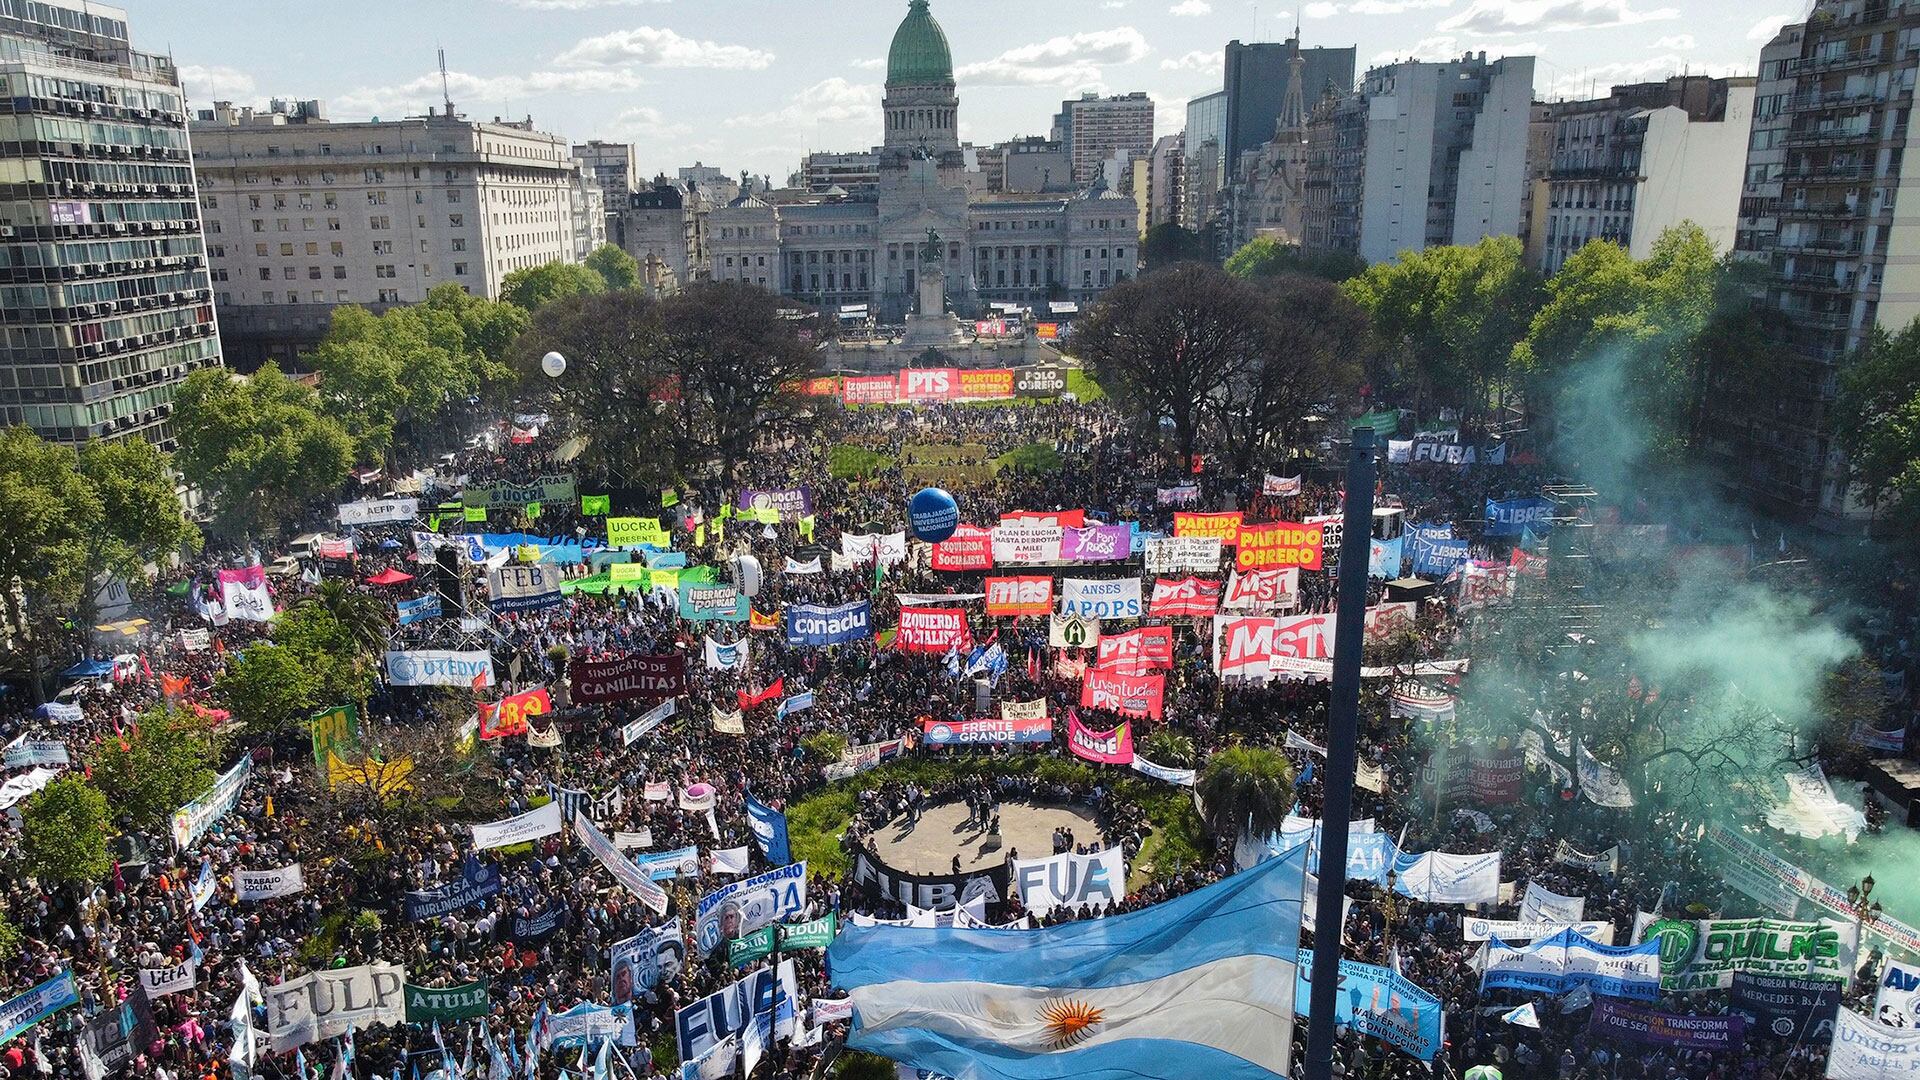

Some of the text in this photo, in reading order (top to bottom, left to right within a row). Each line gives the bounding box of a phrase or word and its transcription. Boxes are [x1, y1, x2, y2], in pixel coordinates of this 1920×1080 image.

[908, 372, 949, 393] PTS
[961, 374, 1011, 383] PARTIDO
[1025, 371, 1056, 380] POLO
[846, 381, 892, 391] IZQUIERDA
[962, 384, 1010, 394] OBRERO
[1018, 380, 1064, 391] OBRERO
[846, 390, 892, 401] SOCIALISTA
[1415, 443, 1476, 464] FUBA
[503, 487, 546, 501] UOCRA
[772, 490, 803, 502] UOCRA
[367, 505, 395, 515] AEFIP
[913, 507, 955, 518] TRABAJADORES
[1499, 507, 1556, 525] LIBRES
[612, 521, 656, 532] UOCRA
[1177, 516, 1240, 529] PARTIDO
[615, 535, 657, 544] PRESENTE
[1021, 536, 1060, 544] DERROTAR
[1241, 530, 1320, 548] PARTIDO
[939, 541, 983, 553] IZQUIERDA
[938, 554, 986, 566] SOCIALISTA
[1239, 548, 1314, 566] OBRERO
[500, 568, 543, 587] FEB
[688, 586, 737, 602] LIBERACIÓN
[1081, 584, 1121, 594] ANSES
[694, 598, 736, 613] POPULAR
[1064, 598, 1139, 617] APOPS
[795, 610, 866, 634] conadu
[901, 612, 960, 629] IZQUIERDA
[1101, 633, 1142, 658] PTS
[1229, 623, 1324, 660] MST
[424, 661, 491, 676] UTEDYC
[588, 658, 667, 678] SINDICATO DE
[581, 676, 677, 696] CANILLITAS
[1086, 671, 1147, 697] Juventud
[1092, 691, 1120, 710] PTS
[962, 722, 1013, 731] FRENTE
[960, 731, 1015, 740] GRANDE
[243, 876, 281, 886] TRABAJO
[747, 863, 803, 888] ROMERO
[1019, 858, 1115, 906] FUA
[243, 884, 273, 892] SOCIAL
[437, 879, 471, 899] ATSA
[413, 888, 482, 918] HURLINGHAM
[698, 882, 738, 917] SERGIO
[788, 922, 829, 936] EDUN
[1373, 968, 1383, 977] DE
[1604, 961, 1649, 973] MIGUEL
[1346, 969, 1375, 982] LOMAS
[1661, 974, 1719, 989] RIAN
[1757, 978, 1787, 989] OBRERA
[275, 972, 400, 1029] FULP
[411, 988, 485, 1008] ATULP
[1741, 989, 1796, 1005] MERCEDES
[1603, 1005, 1614, 1013] LA
[1666, 1018, 1728, 1030] TRANSFORMA
[1351, 1007, 1430, 1048] WALTER MERKIS
[1609, 1016, 1627, 1028] QUE
[1630, 1022, 1648, 1032] SEA
[1693, 1031, 1728, 1041] IGUALA
